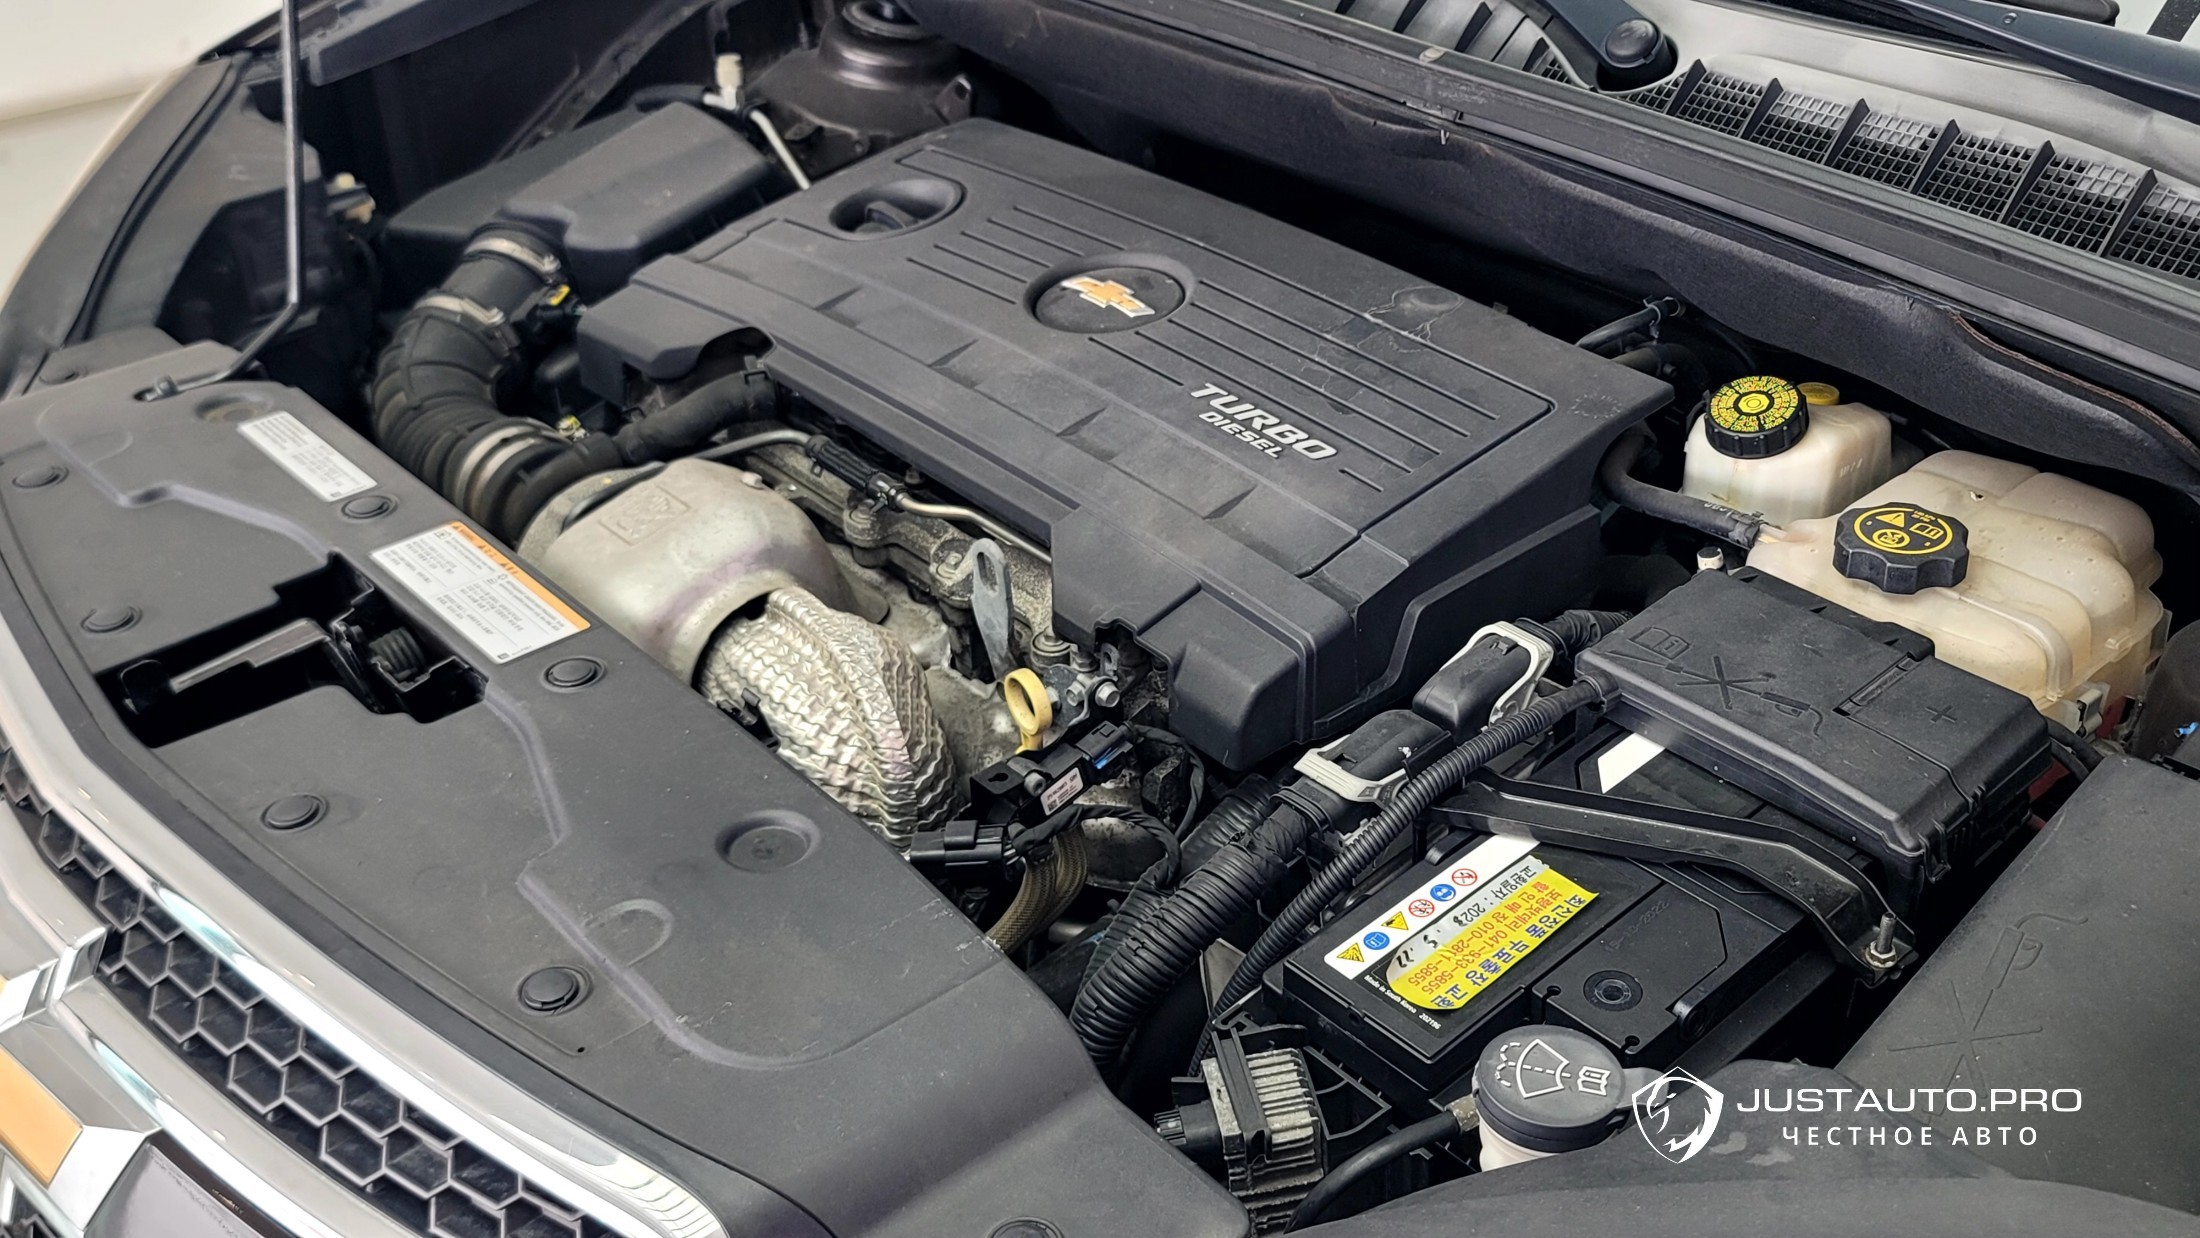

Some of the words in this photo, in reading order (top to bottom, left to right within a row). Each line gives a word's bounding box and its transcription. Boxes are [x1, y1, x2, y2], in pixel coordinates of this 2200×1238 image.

[1190, 382, 1338, 460] TURBO
[1199, 411, 1283, 459] DIESEL
[1490, 866, 1537, 900] 교환일자
[1507, 888, 1563, 932] 보령밧데리
[1525, 894, 1586, 939] 최신정품
[1408, 922, 1495, 986] 010-2811-5855
[1421, 931, 1508, 995] 041-933-5855
[1465, 939, 1530, 987] 무료출장
[1364, 975, 1380, 988] Made
[1385, 990, 1401, 1003] South
[1400, 1000, 1417, 1013] Korea
[1431, 983, 1468, 1008] 교환
